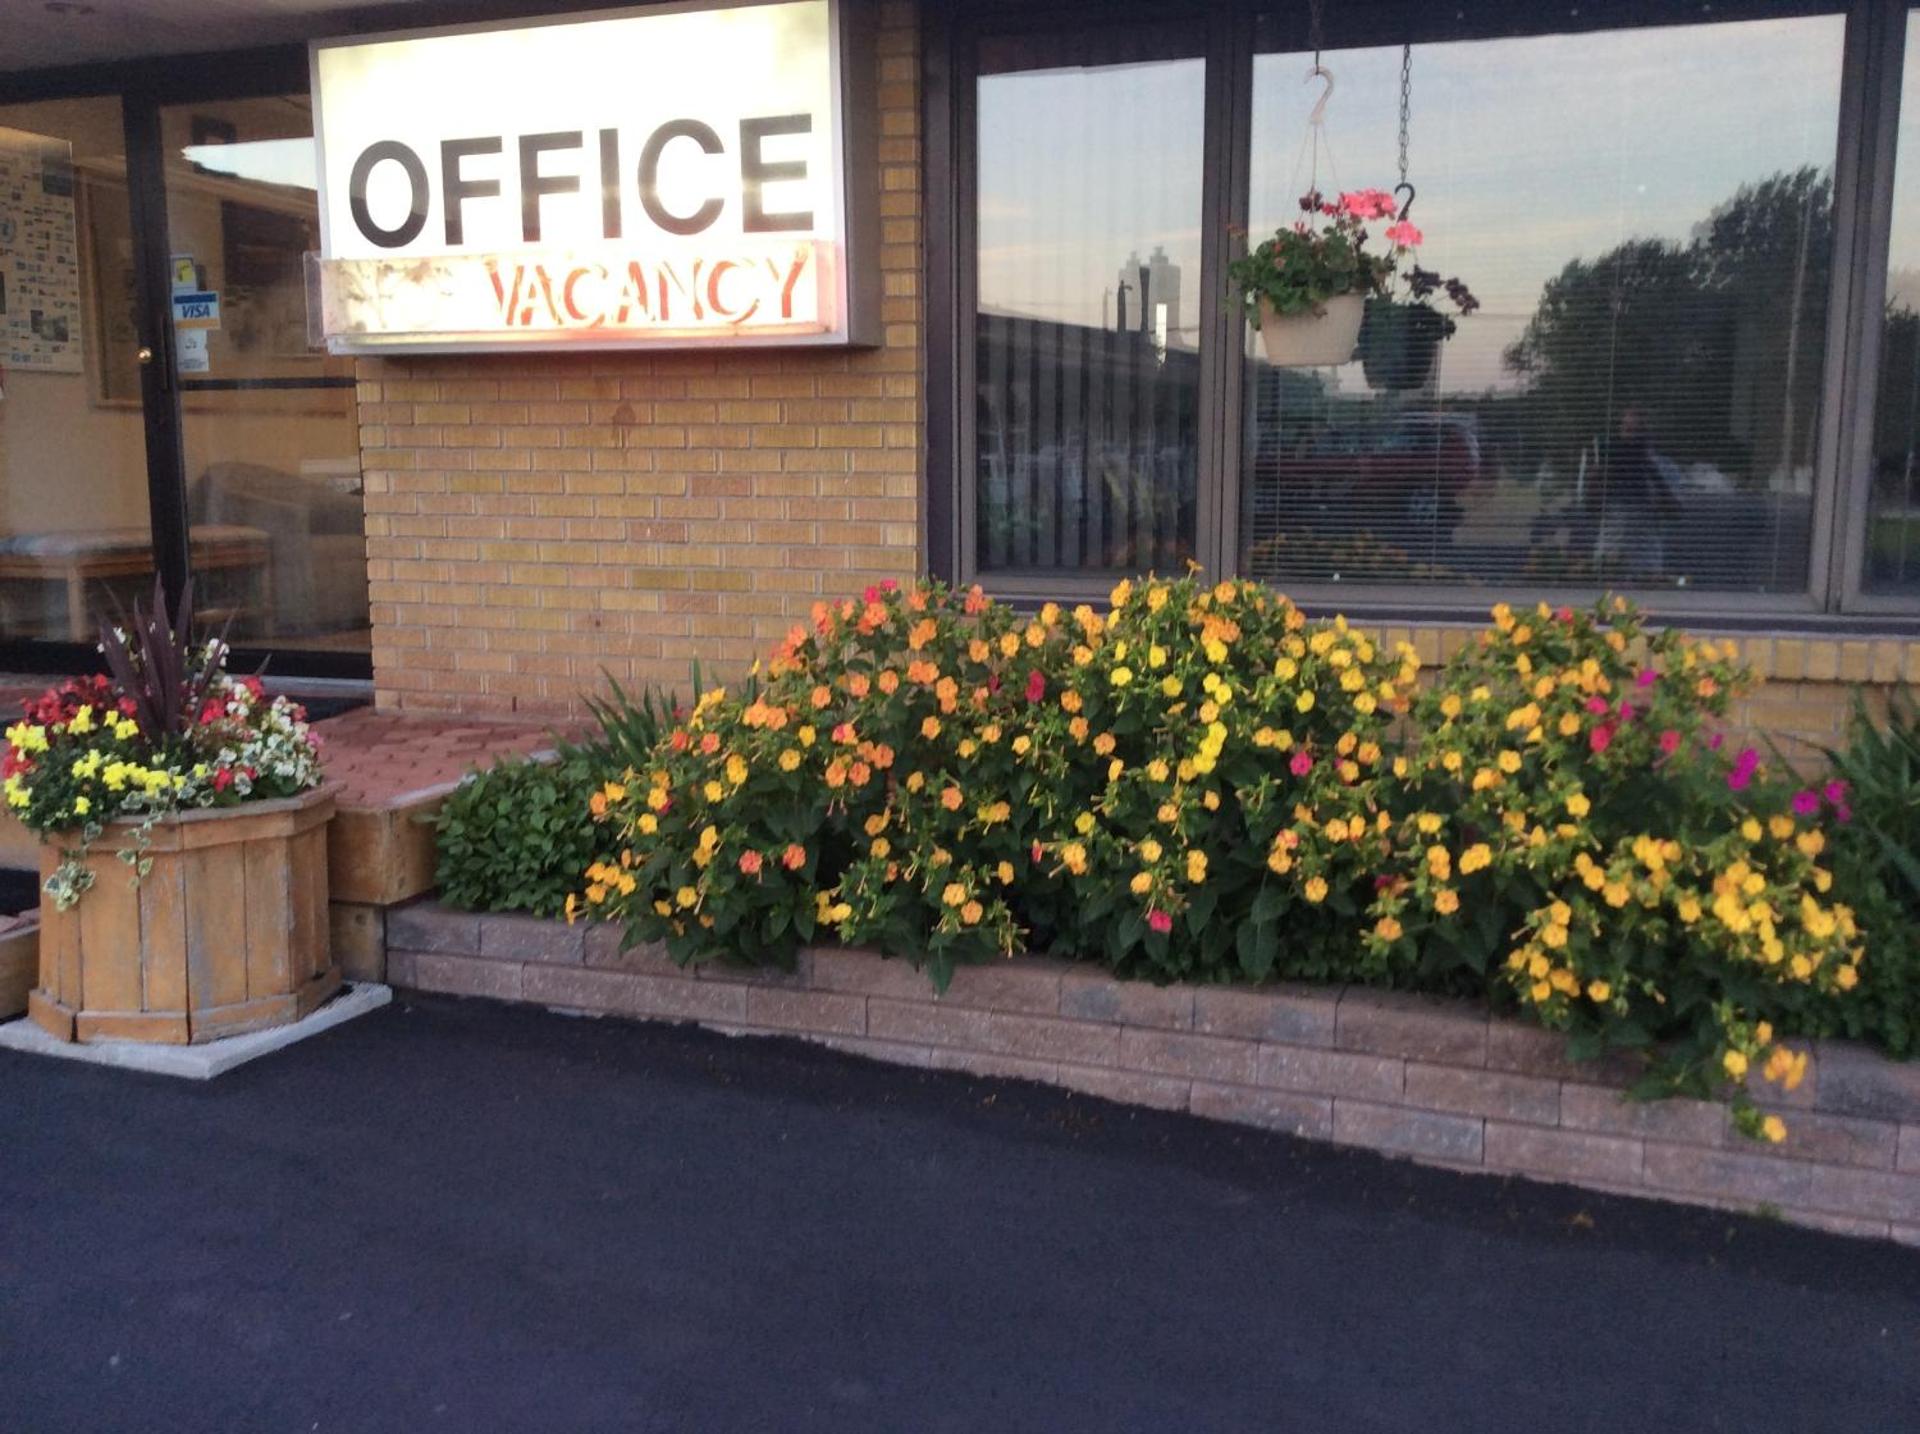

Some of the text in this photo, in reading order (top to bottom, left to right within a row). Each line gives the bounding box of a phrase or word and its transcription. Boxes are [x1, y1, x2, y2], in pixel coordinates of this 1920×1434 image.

[349, 113, 814, 249] OFFICE
[182, 305, 210, 318] VISA
[486, 248, 806, 329] VACANCY
